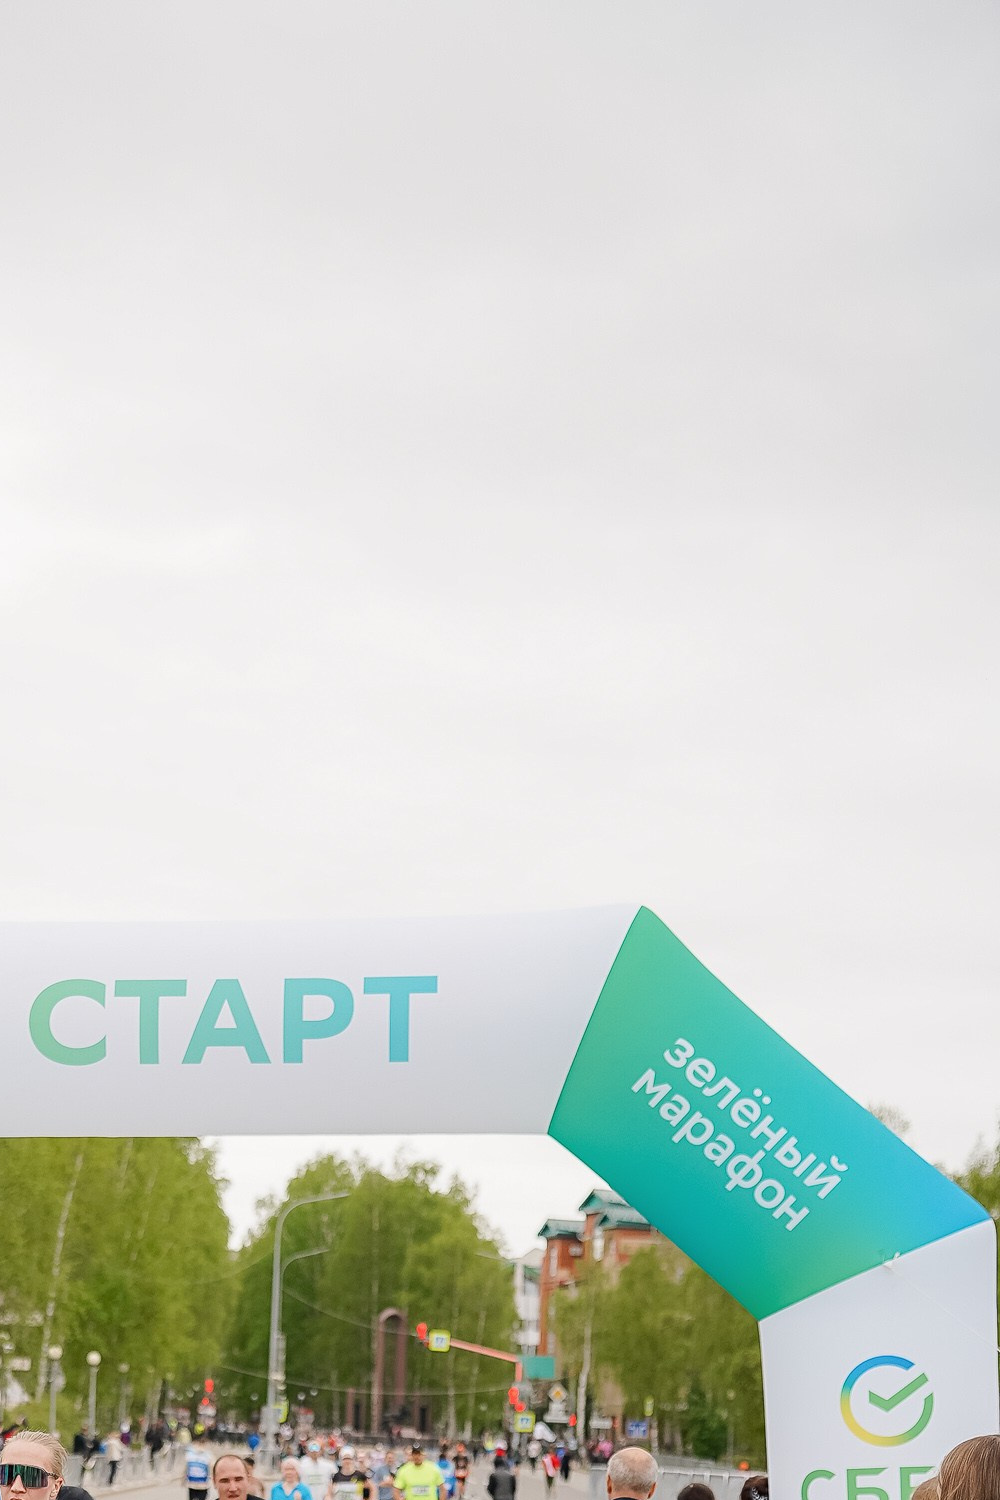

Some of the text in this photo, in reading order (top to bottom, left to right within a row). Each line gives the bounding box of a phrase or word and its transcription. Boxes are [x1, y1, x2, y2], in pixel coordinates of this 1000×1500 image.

[28, 975, 438, 1066] СТАРТ
[631, 1068, 810, 1232] марафон
[663, 1037, 848, 1200] зелёный
